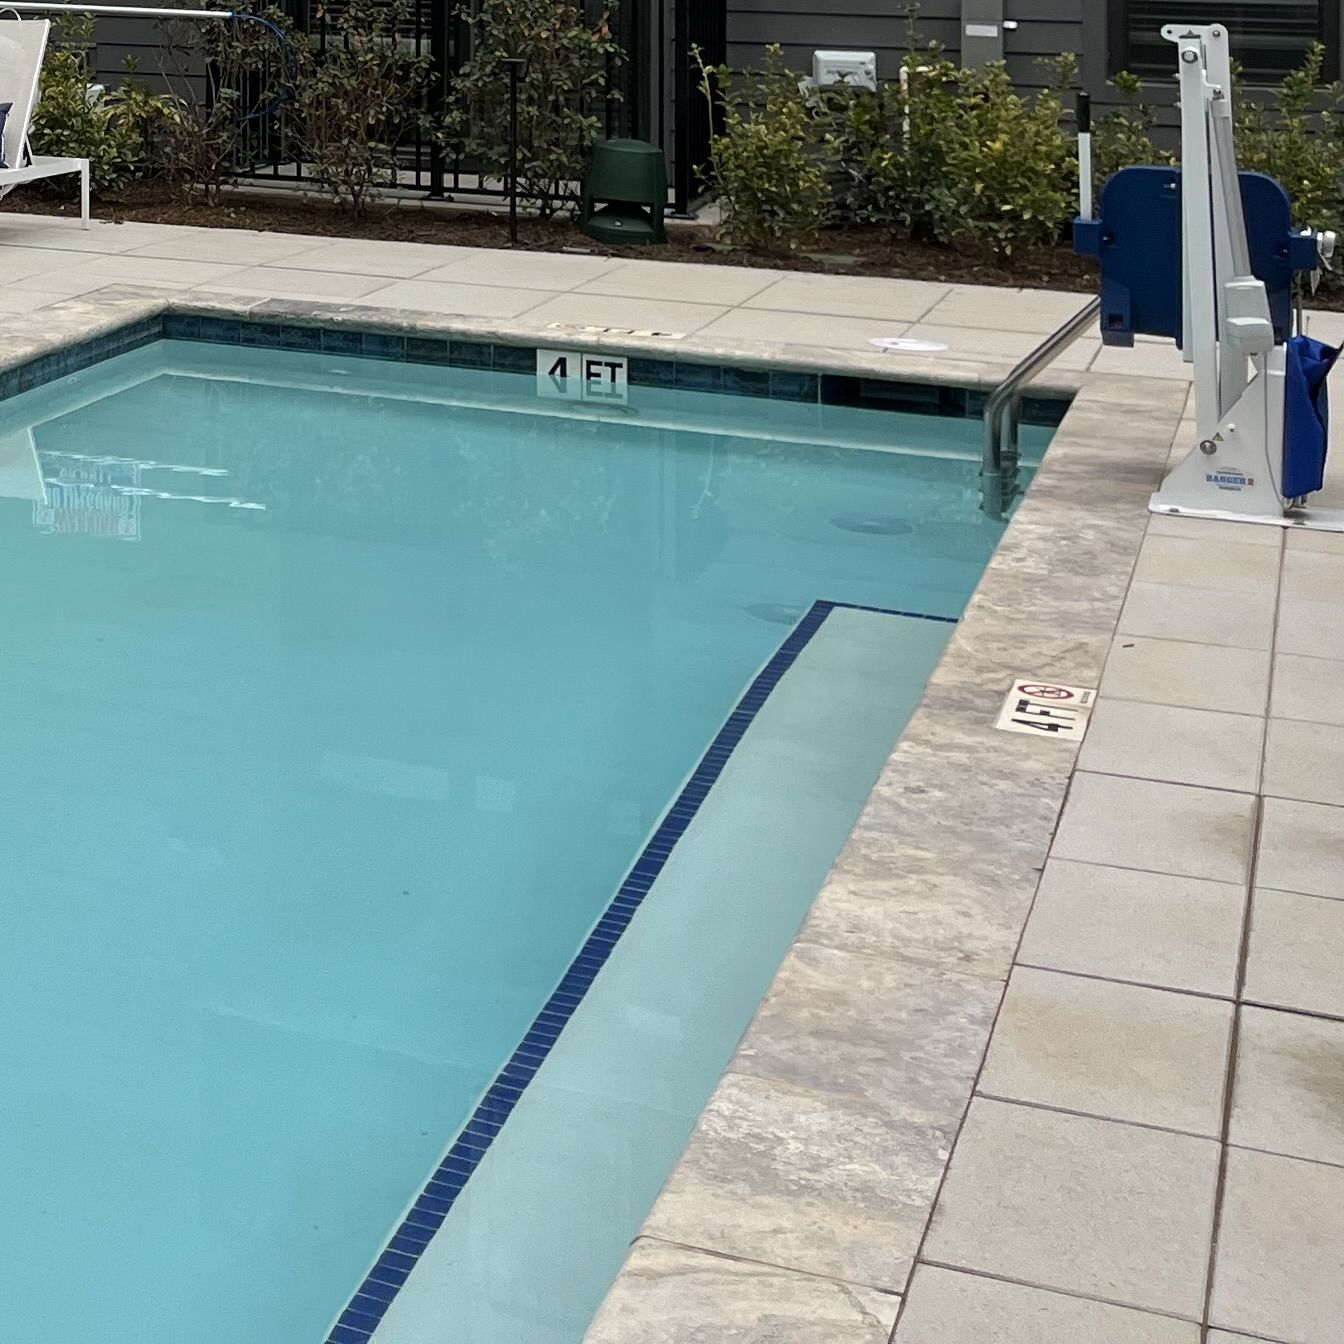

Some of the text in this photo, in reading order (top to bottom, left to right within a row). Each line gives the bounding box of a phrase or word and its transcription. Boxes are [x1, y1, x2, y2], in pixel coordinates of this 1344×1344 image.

[548, 357, 623, 383] 4 FT
[1011, 699, 1078, 733] 4 FT
